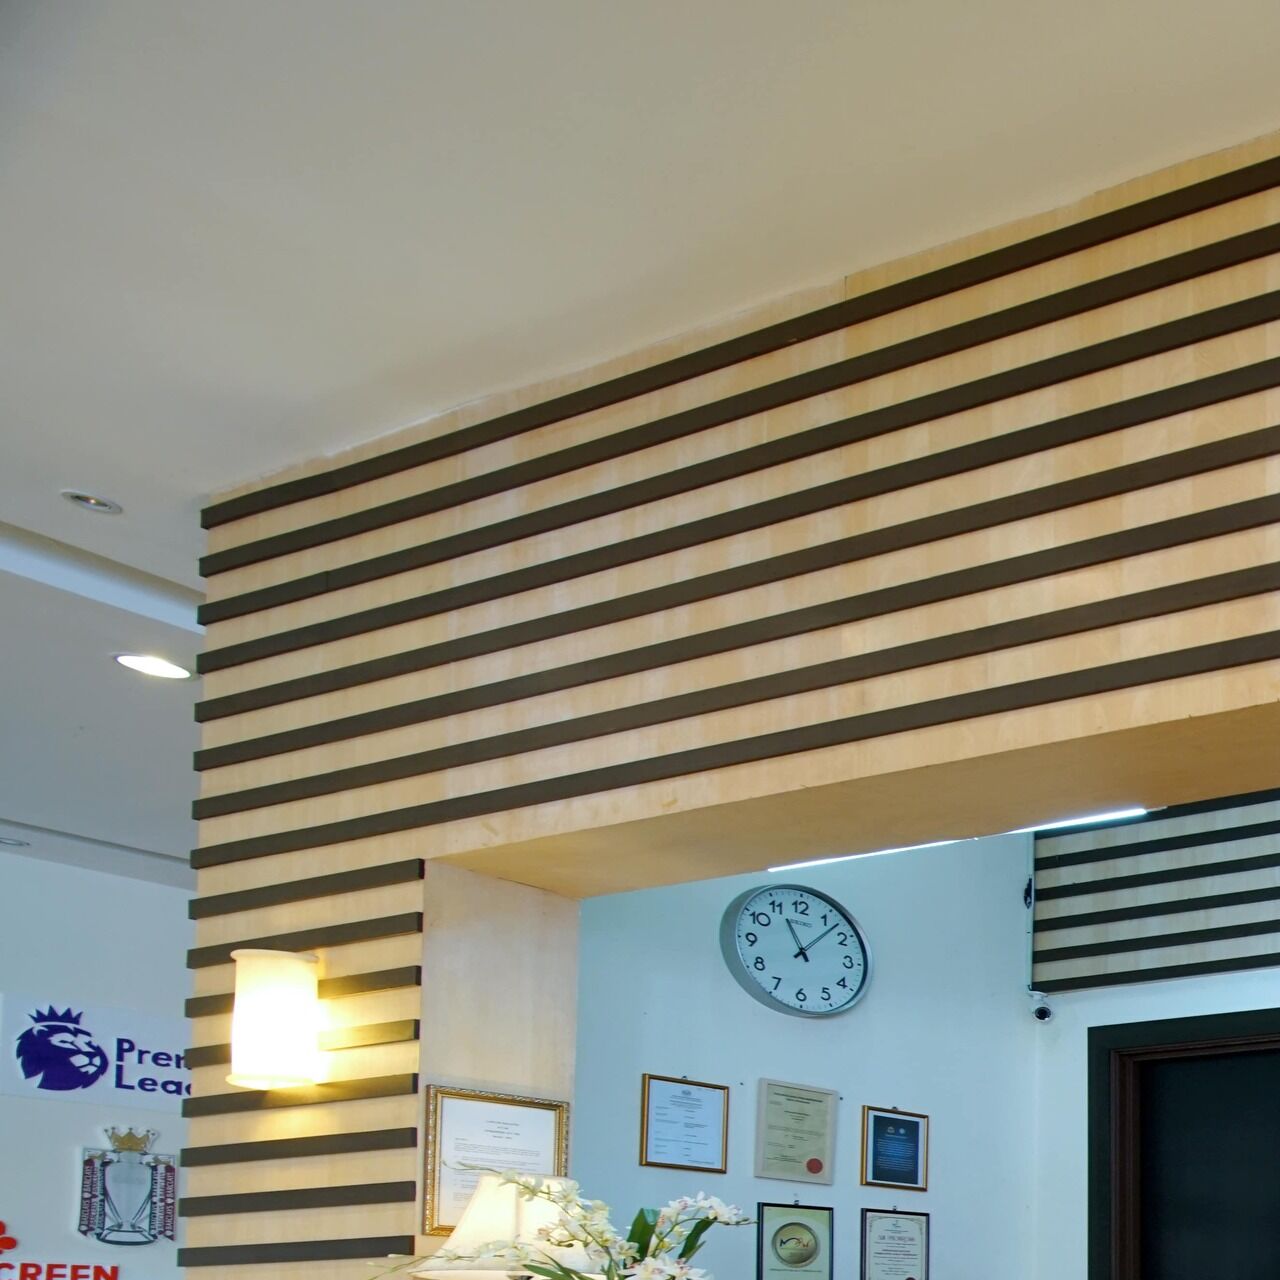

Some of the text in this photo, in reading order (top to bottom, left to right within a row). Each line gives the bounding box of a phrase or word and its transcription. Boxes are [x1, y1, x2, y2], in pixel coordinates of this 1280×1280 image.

[769, 900, 783, 915] 11
[792, 900, 809, 916] 12
[749, 911, 771, 927] 10
[820, 914, 828, 926] 1
[745, 932, 758, 946] 9
[837, 932, 848, 946] 2
[754, 956, 766, 971] 8
[842, 955, 854, 969] 3
[771, 976, 782, 990] 7
[836, 977, 848, 989] 4
[795, 988, 807, 1002] 6
[820, 987, 831, 1001] 5
